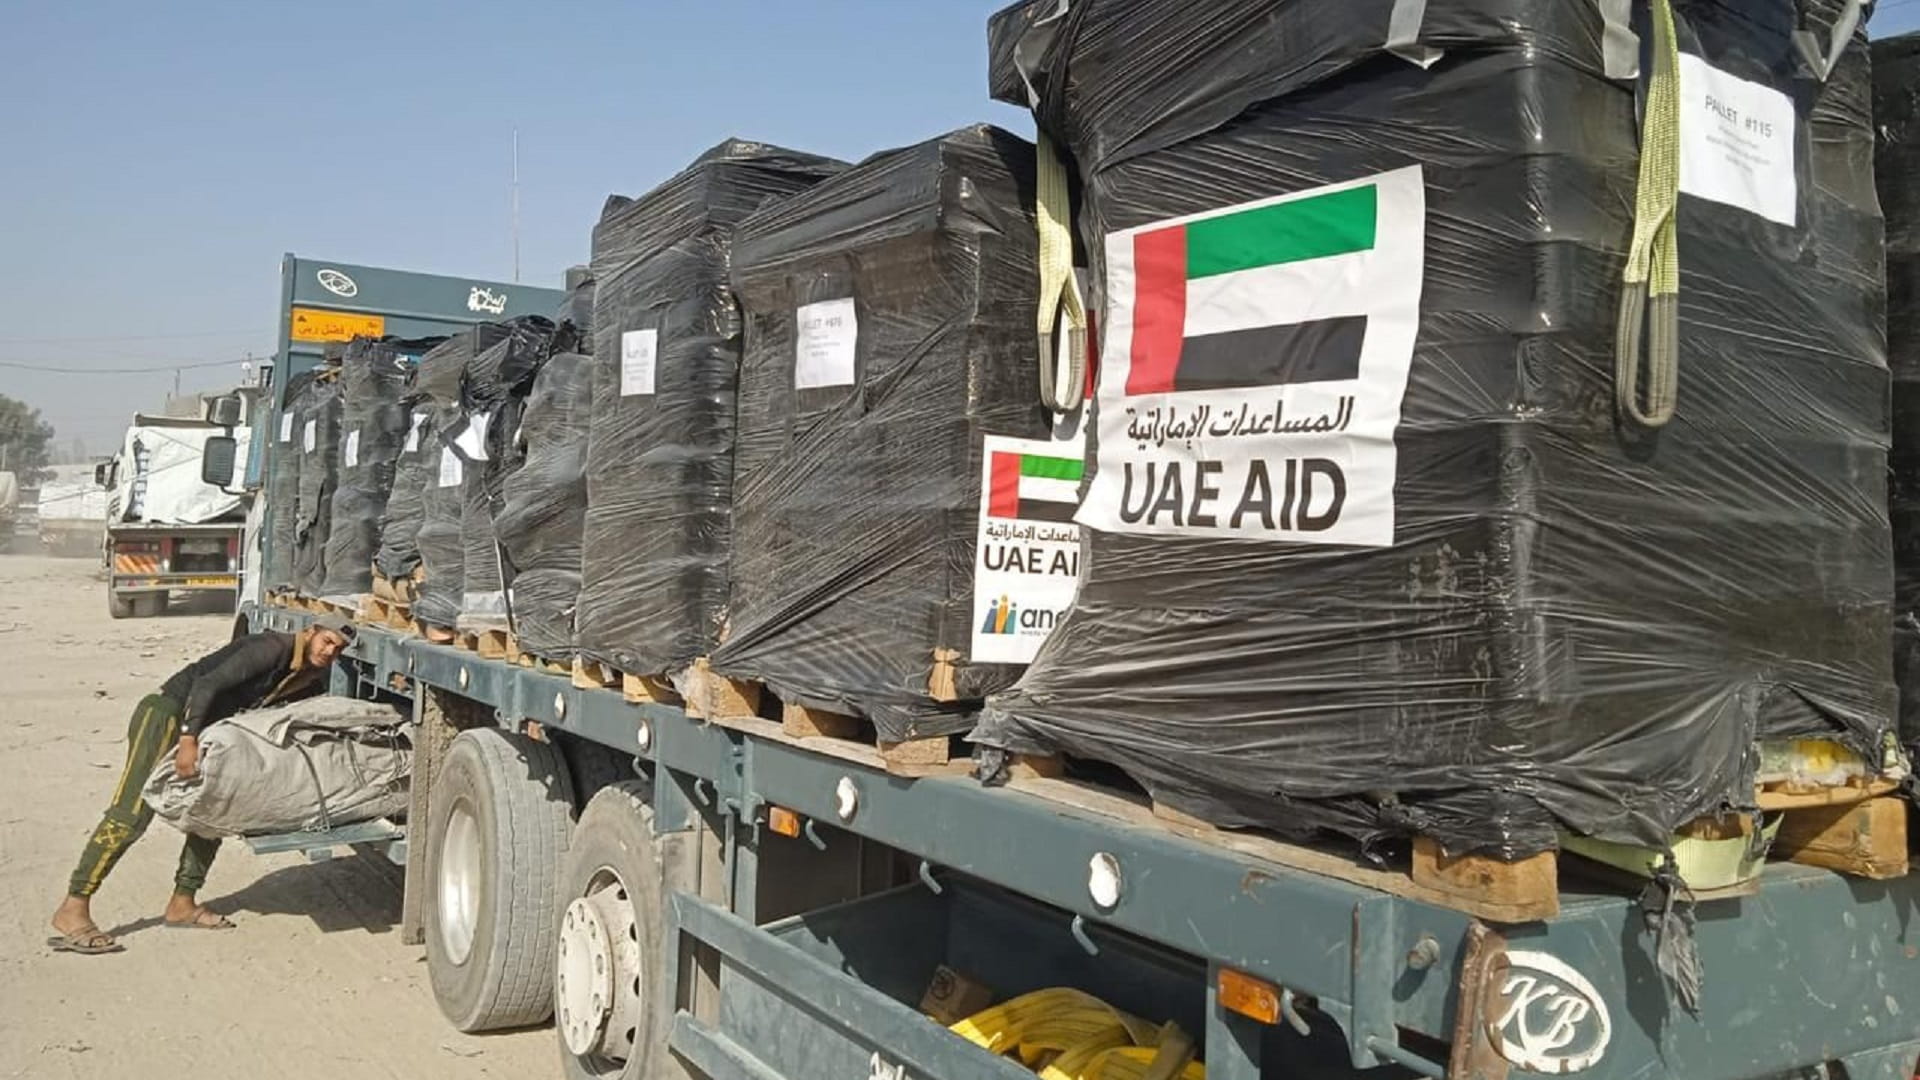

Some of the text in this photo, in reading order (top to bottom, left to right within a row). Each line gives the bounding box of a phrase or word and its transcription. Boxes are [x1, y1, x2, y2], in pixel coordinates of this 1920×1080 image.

[1125, 405, 1210, 450] الإماراتية
[1208, 396, 1355, 438] المساعدات
[1120, 458, 1347, 532] UAE AID
[983, 544, 1078, 577] UAE AI
